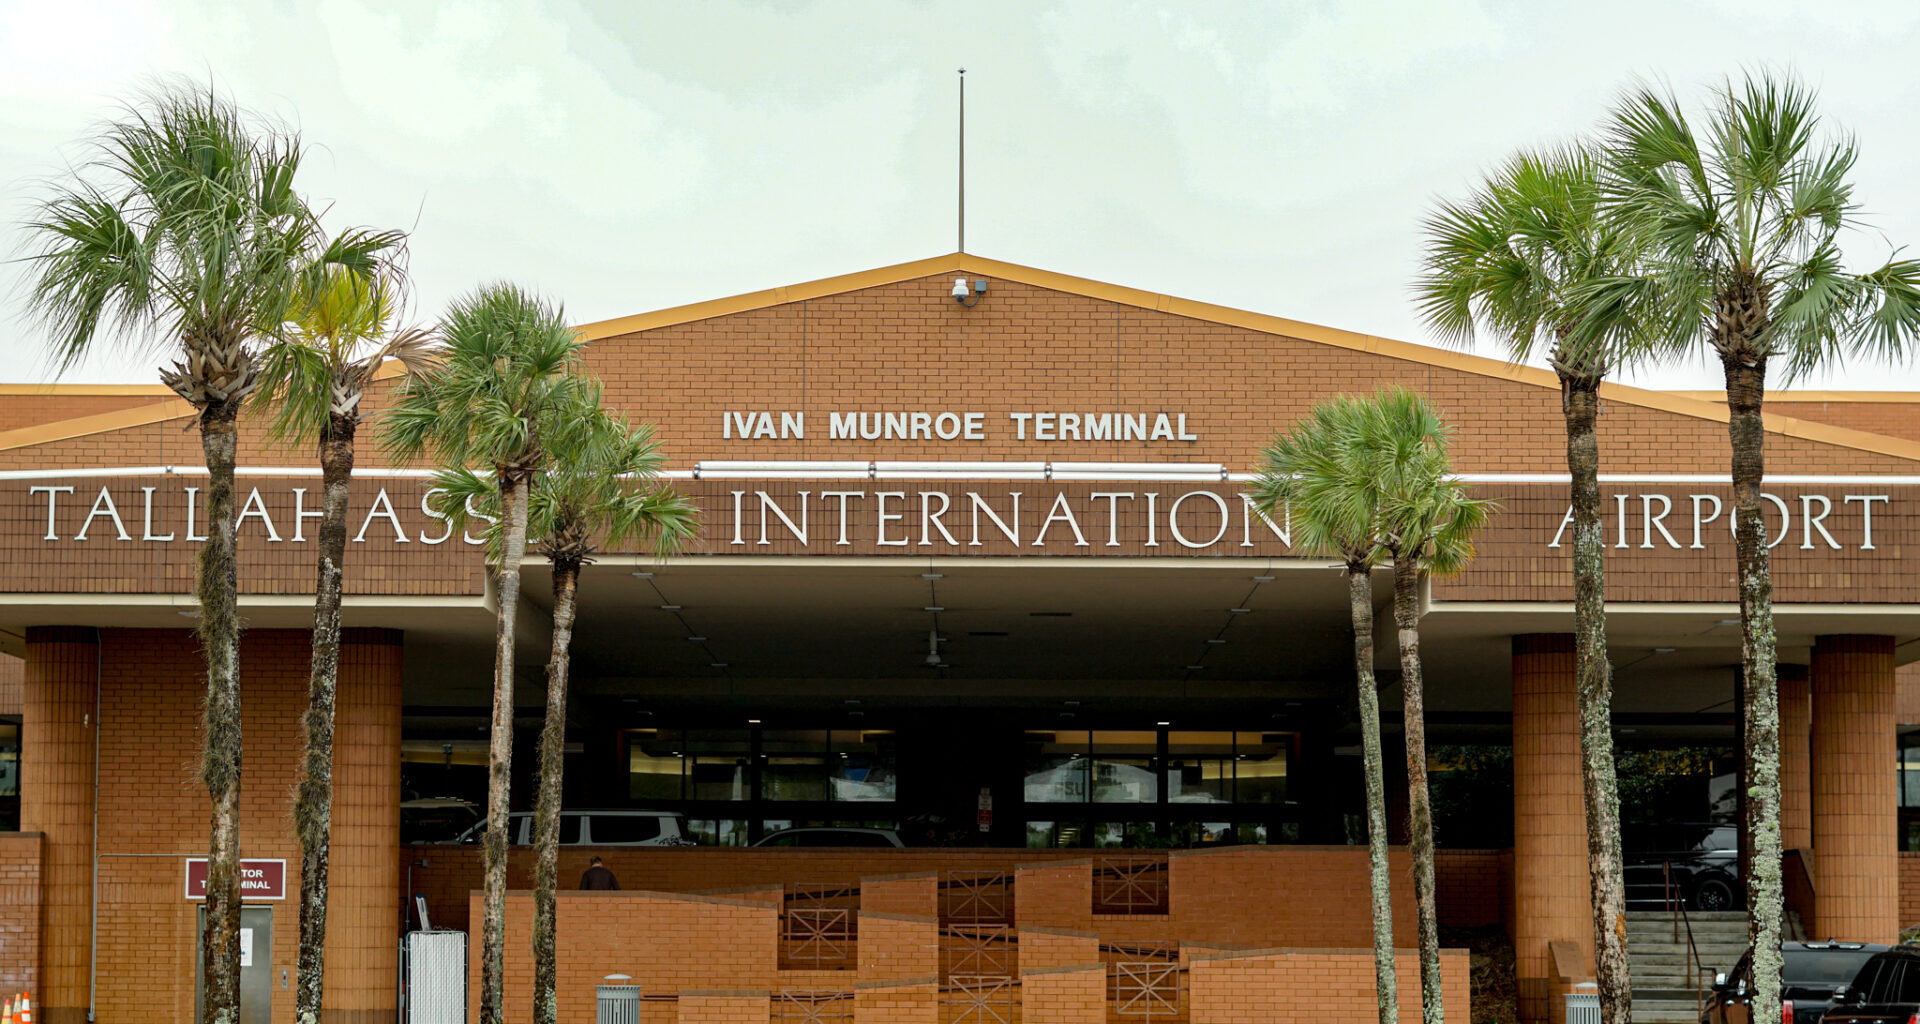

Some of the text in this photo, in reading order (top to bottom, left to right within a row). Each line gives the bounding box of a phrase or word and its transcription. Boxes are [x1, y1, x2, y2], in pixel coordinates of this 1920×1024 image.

[723, 411, 1197, 441] IVAN MUNROE TERMINAL
[730, 490, 1380, 549] INTERNATION
